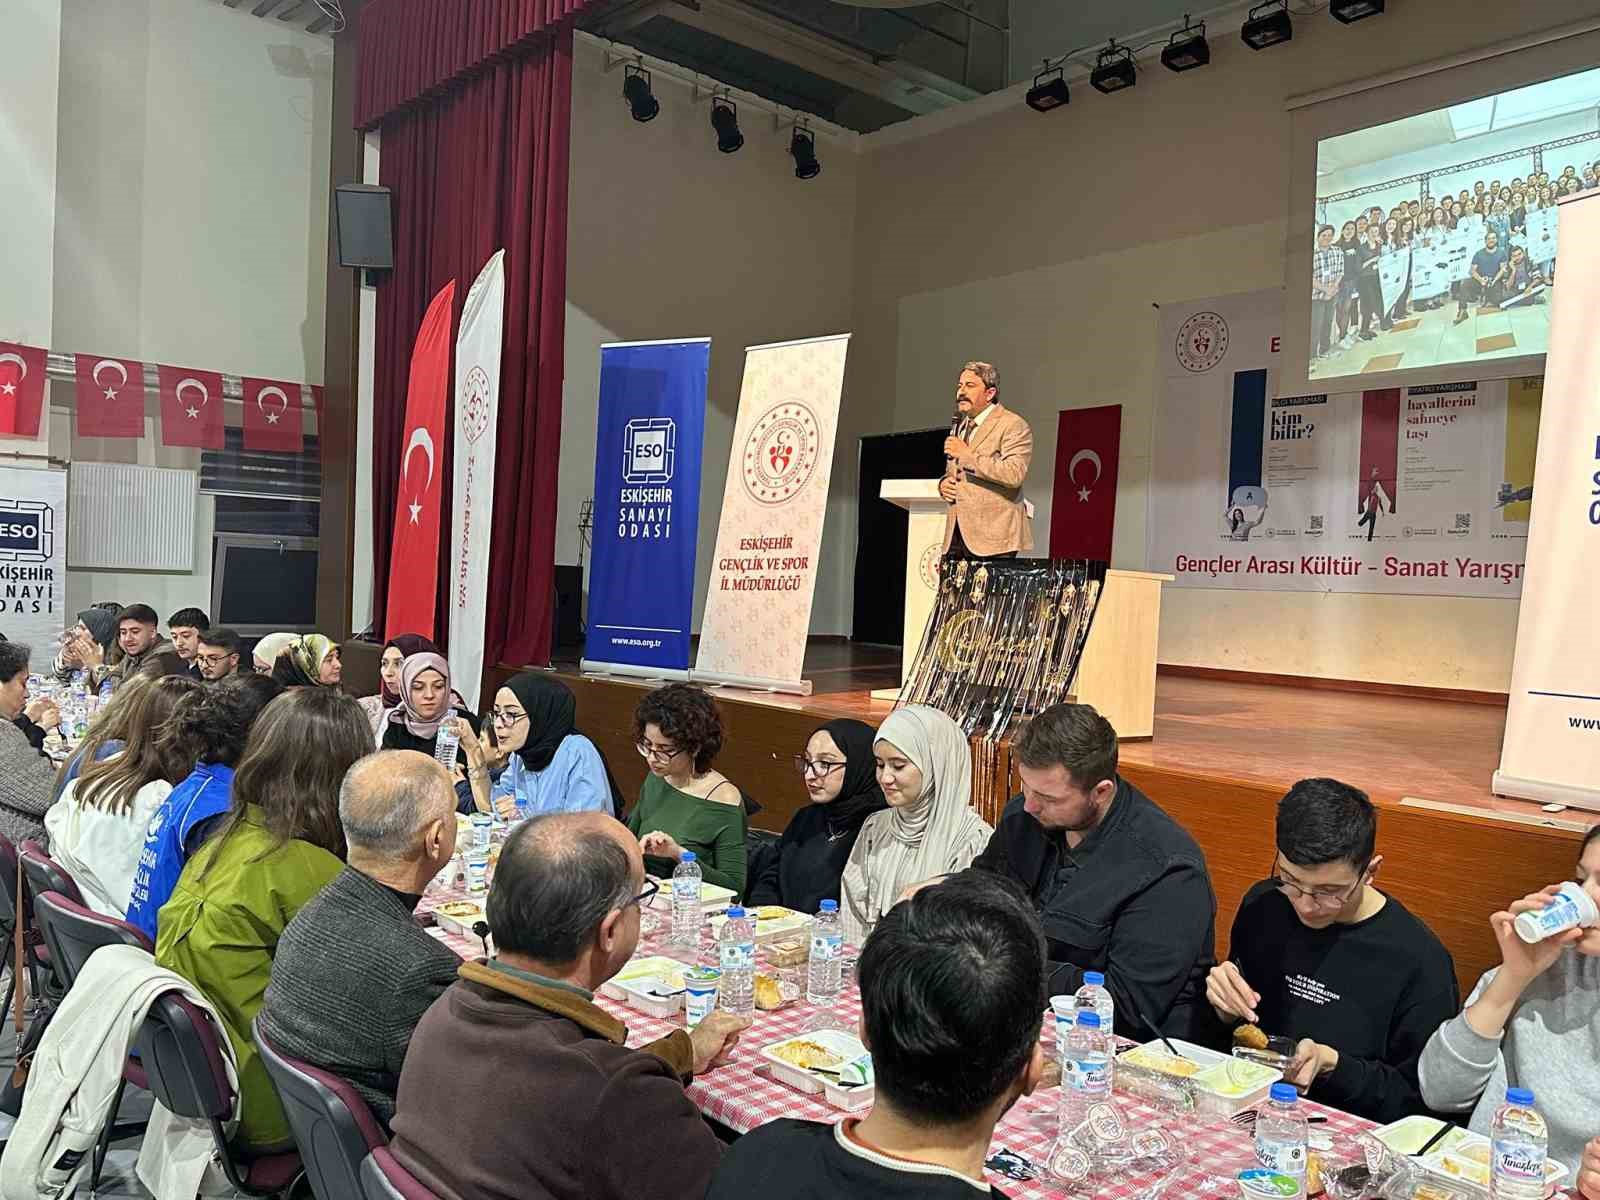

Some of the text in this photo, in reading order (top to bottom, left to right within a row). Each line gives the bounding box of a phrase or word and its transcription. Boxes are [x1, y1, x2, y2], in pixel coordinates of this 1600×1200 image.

[1271, 411, 1302, 425] kim
[1271, 424, 1314, 440] bilir?
[635, 444, 662, 458] ESO
[621, 486, 672, 506] ESKİŞEHİR
[620, 505, 671, 522] SANAYİ
[619, 524, 670, 538] ODASI
[740, 534, 793, 552] ESKİŞEHİR
[719, 555, 809, 573] GENÇLİK VE SPOR
[1176, 554, 1242, 577] Gençler
[1246, 555, 1294, 574] Arası
[1300, 556, 1362, 576] Kültür
[1384, 556, 1448, 577] Sanat
[720, 575, 801, 591] İL MÜDÜRLÜĞÜ
[611, 637, 662, 648] www.eso.org.tr
